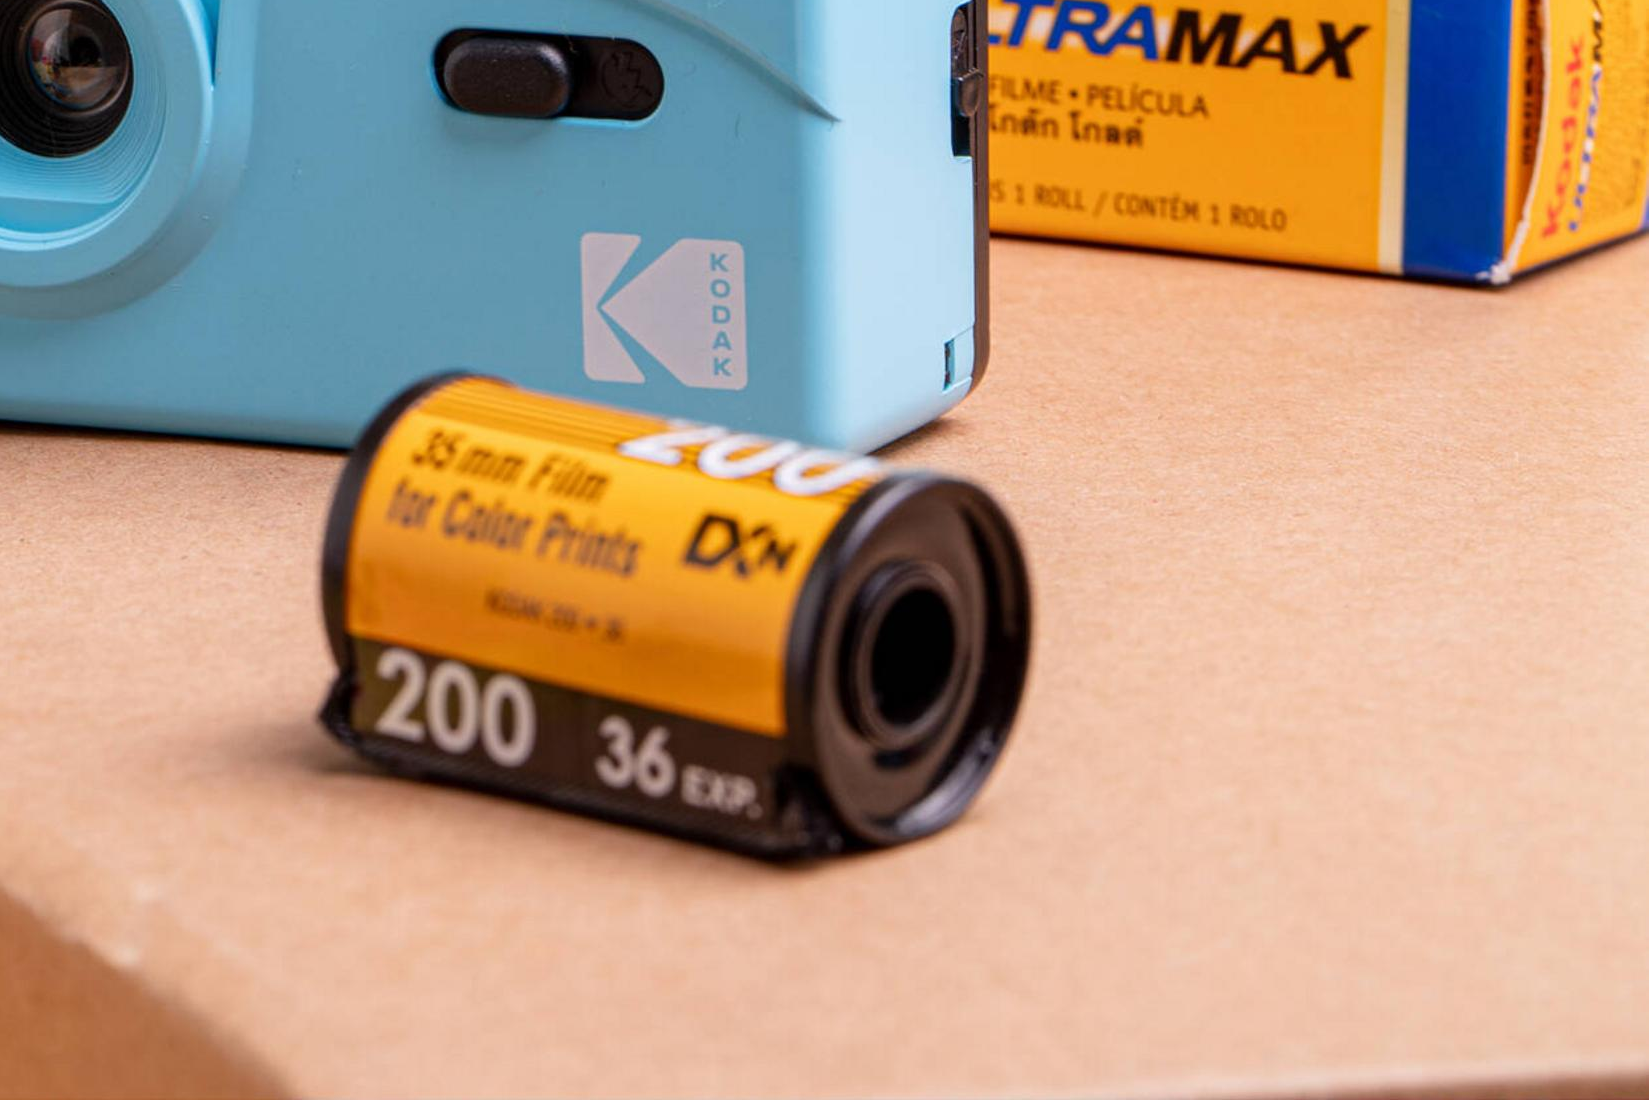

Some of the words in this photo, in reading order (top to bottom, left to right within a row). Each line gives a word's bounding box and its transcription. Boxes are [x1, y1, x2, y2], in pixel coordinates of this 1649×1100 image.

[1085, 82, 1210, 118] PELÍCULA
[1034, 183, 1085, 211] ROLL
[1113, 190, 1200, 222] CONTÉM
[1229, 204, 1288, 231] ROLO
[709, 252, 733, 378] KODAK
[527, 453, 611, 504] Film
[385, 475, 438, 530] for
[439, 488, 535, 556] Color
[534, 509, 644, 579] Prints
[375, 647, 537, 768] 200
[594, 715, 677, 799] 36
